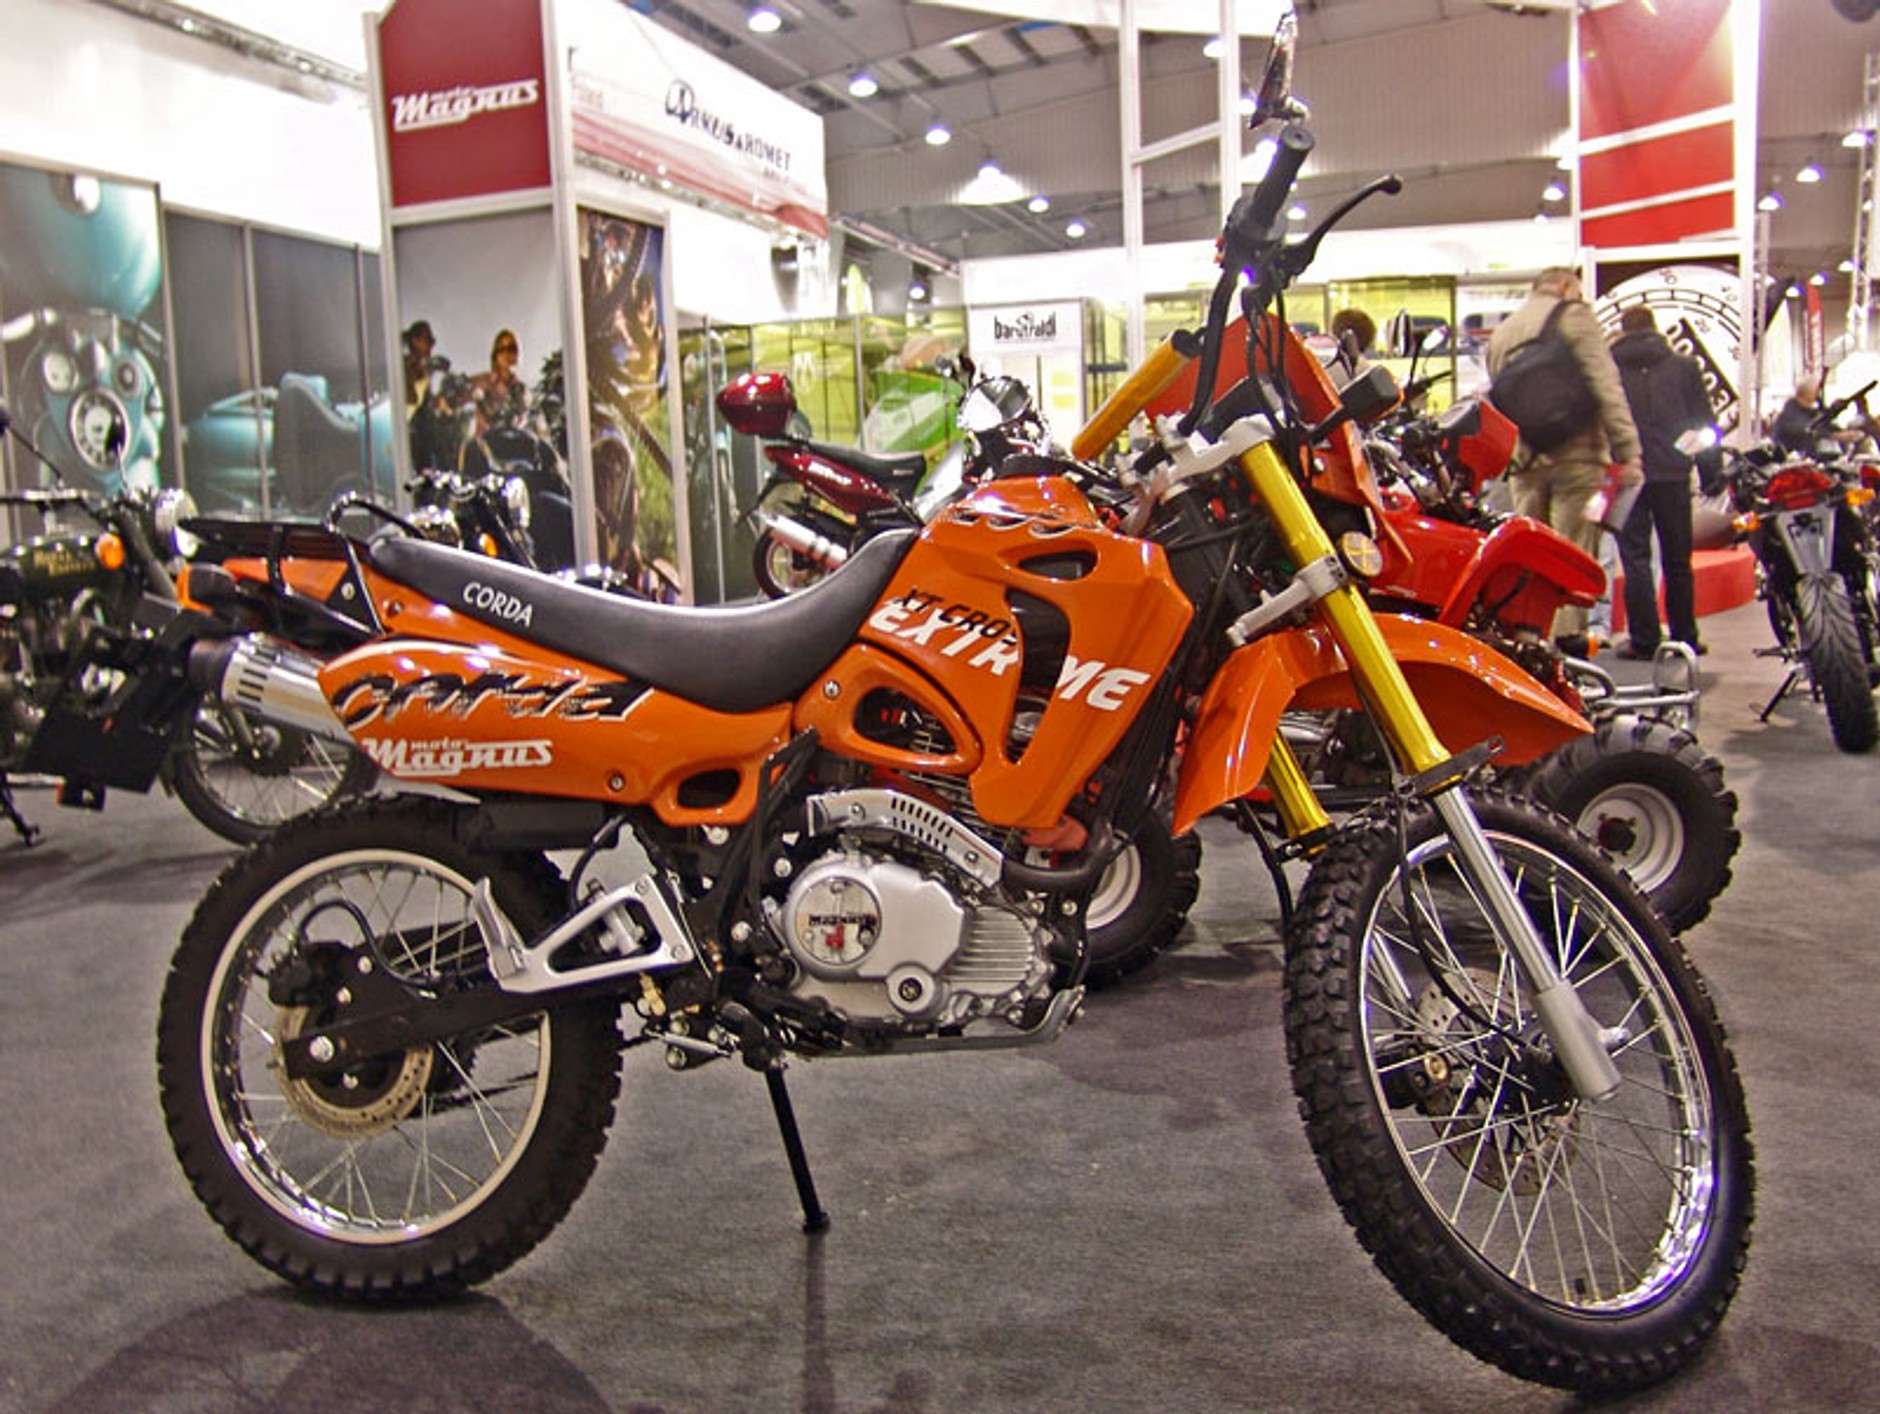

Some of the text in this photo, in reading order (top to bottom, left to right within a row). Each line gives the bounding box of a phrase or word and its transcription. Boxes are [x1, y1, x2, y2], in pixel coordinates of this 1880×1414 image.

[392, 79, 539, 132] Magnus
[463, 582, 532, 628] CORDA
[894, 588, 944, 612] XT
[868, 596, 1151, 710] EXTRME
[361, 739, 552, 776] Magnus
